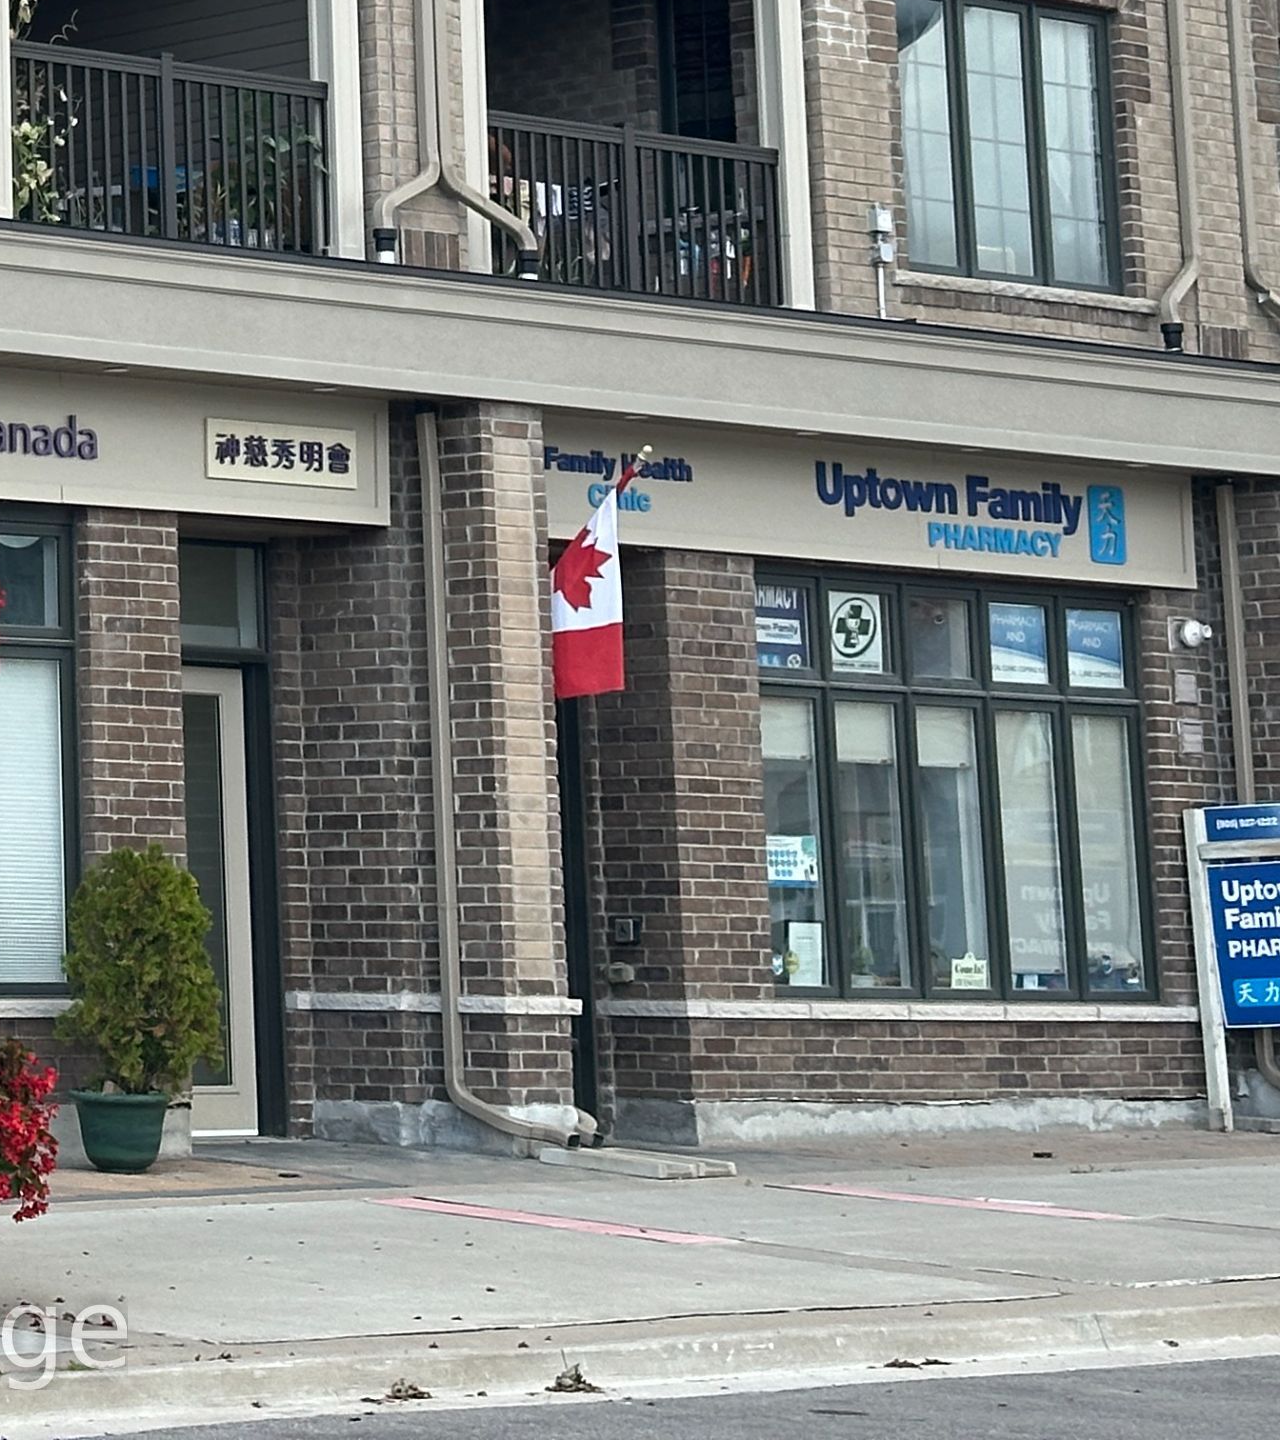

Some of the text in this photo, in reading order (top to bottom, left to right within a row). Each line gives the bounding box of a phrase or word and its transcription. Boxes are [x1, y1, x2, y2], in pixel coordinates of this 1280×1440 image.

[544, 446, 616, 481] Family
[815, 460, 1083, 536] Uptown Family
[928, 522, 1062, 558] PHARMACY
